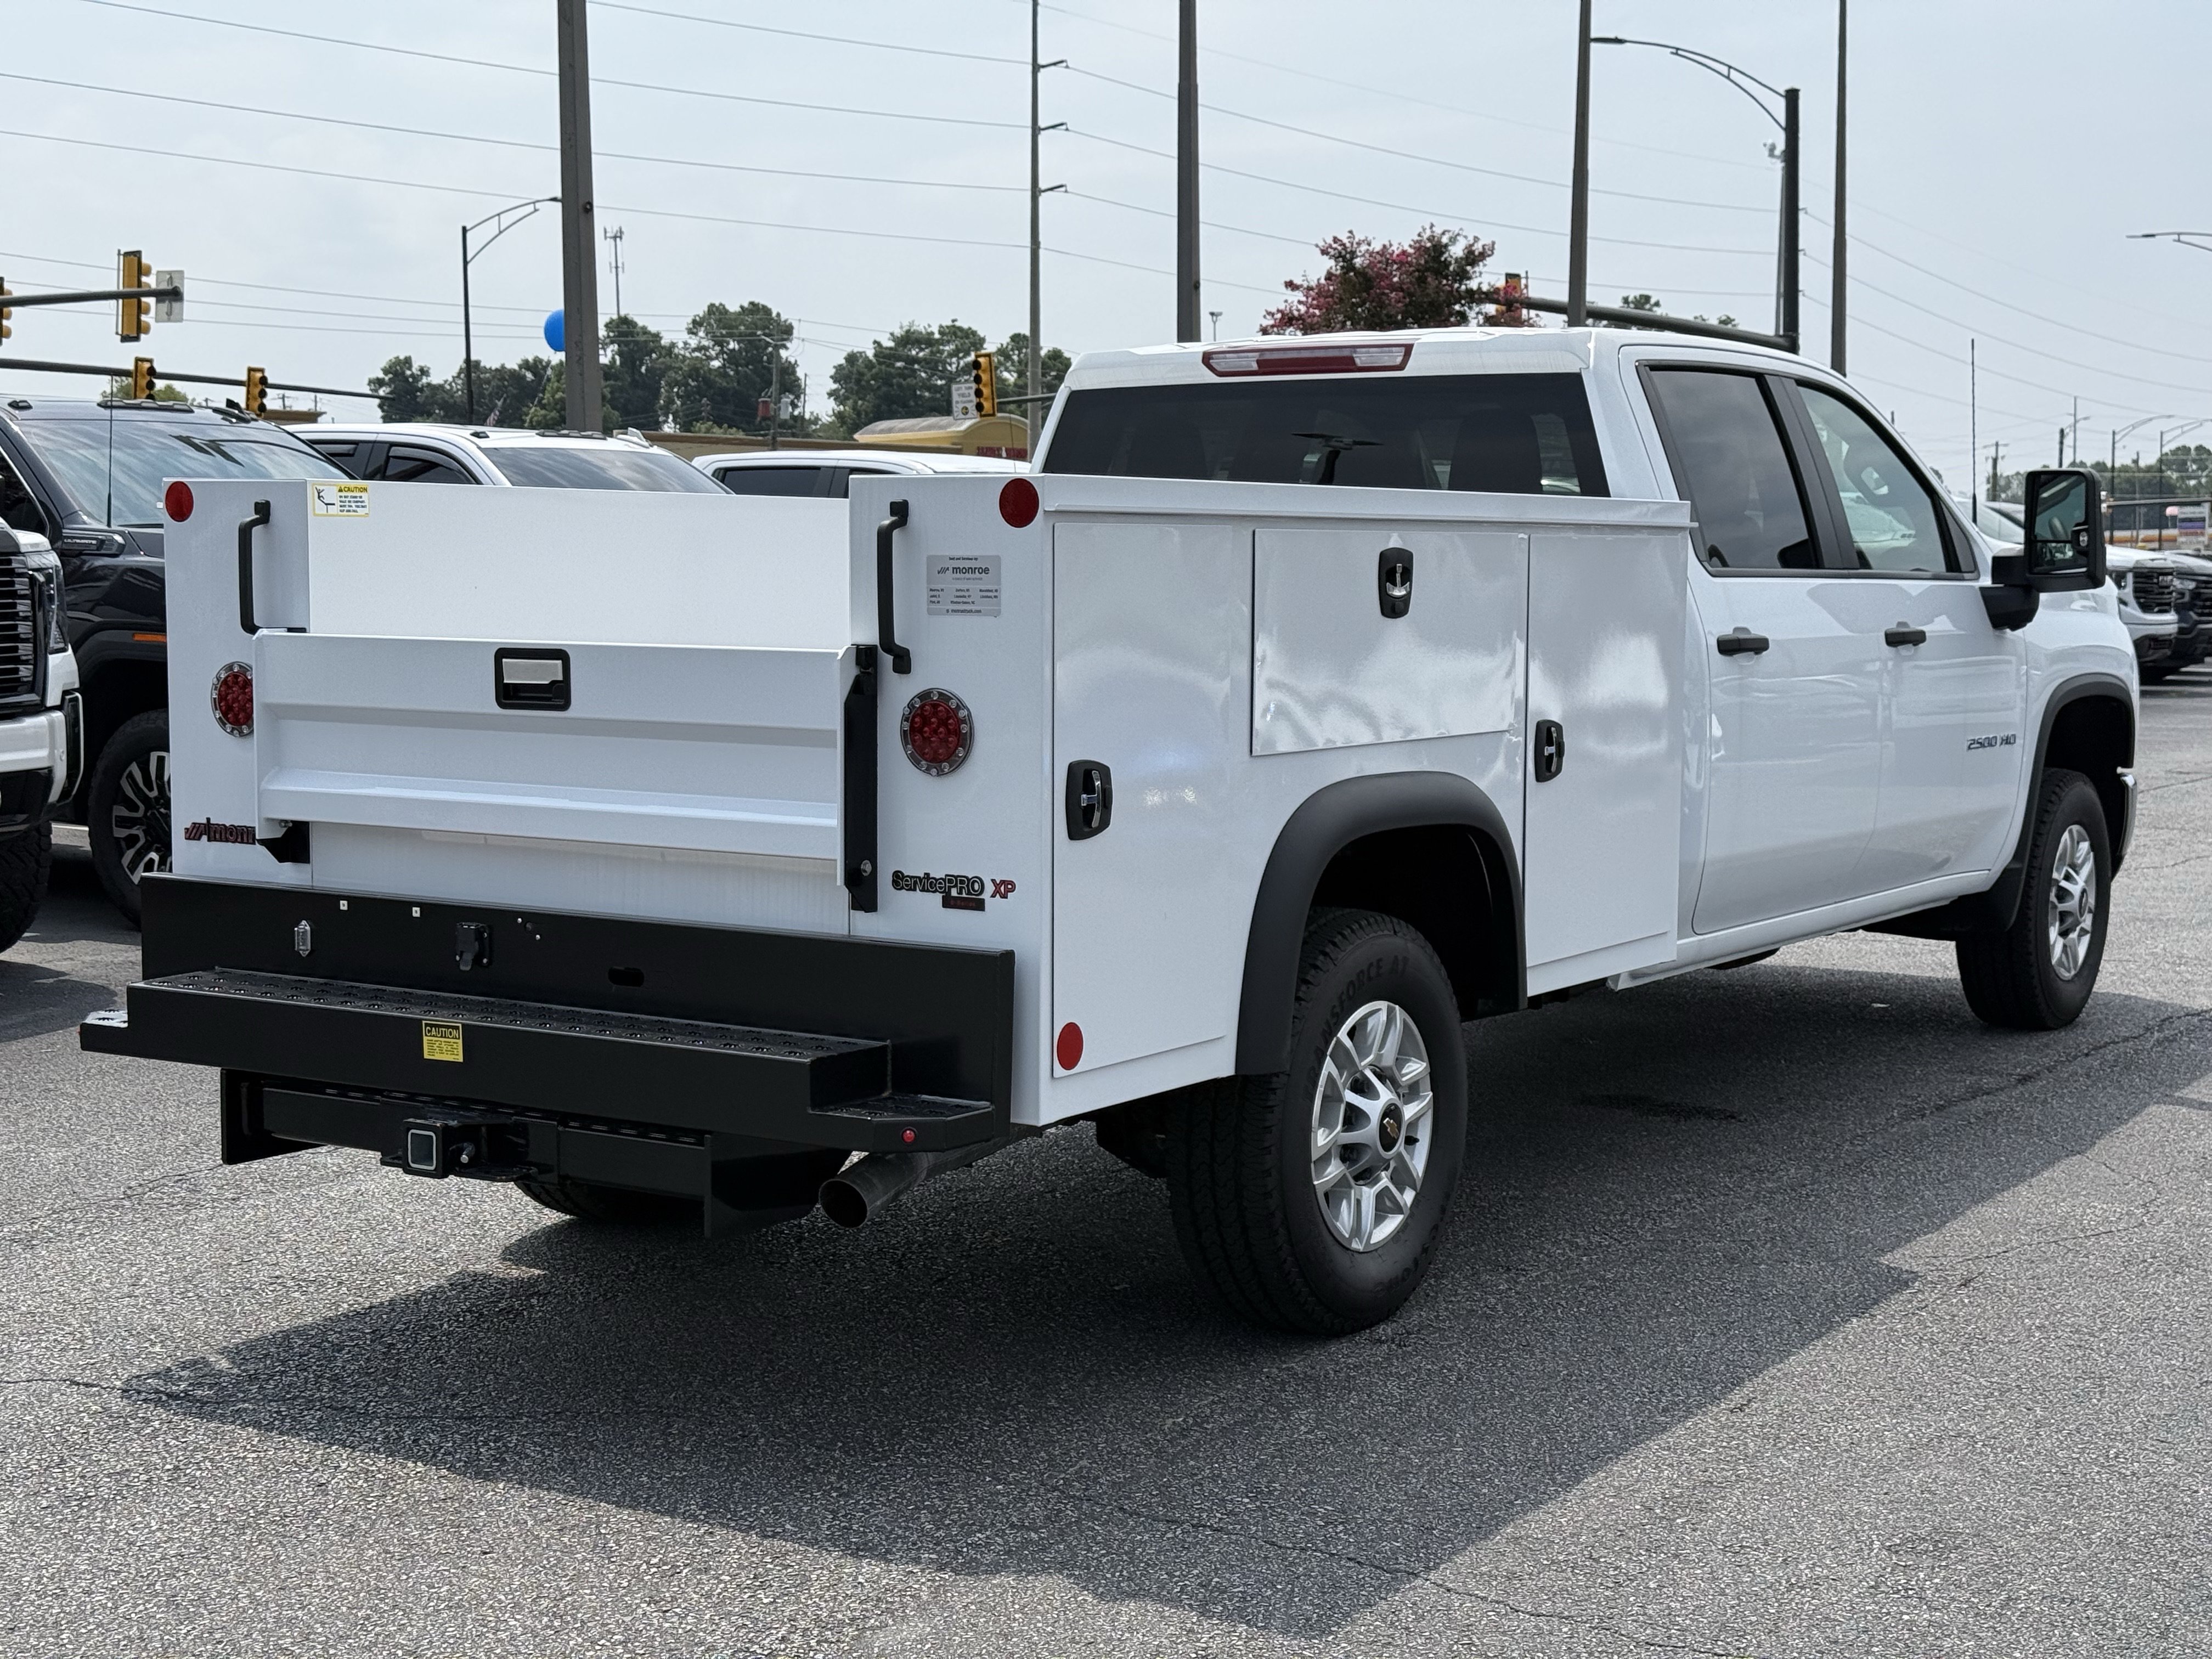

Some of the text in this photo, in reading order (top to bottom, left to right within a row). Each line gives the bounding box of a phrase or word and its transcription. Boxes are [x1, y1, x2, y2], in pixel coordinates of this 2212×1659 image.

[952, 566, 990, 575] monroe
[1967, 733, 2017, 751] 2500 HD
[209, 824, 256, 844] monr
[892, 870, 1016, 899] ServicePRO XP
[426, 1026, 459, 1039] CAUTION
